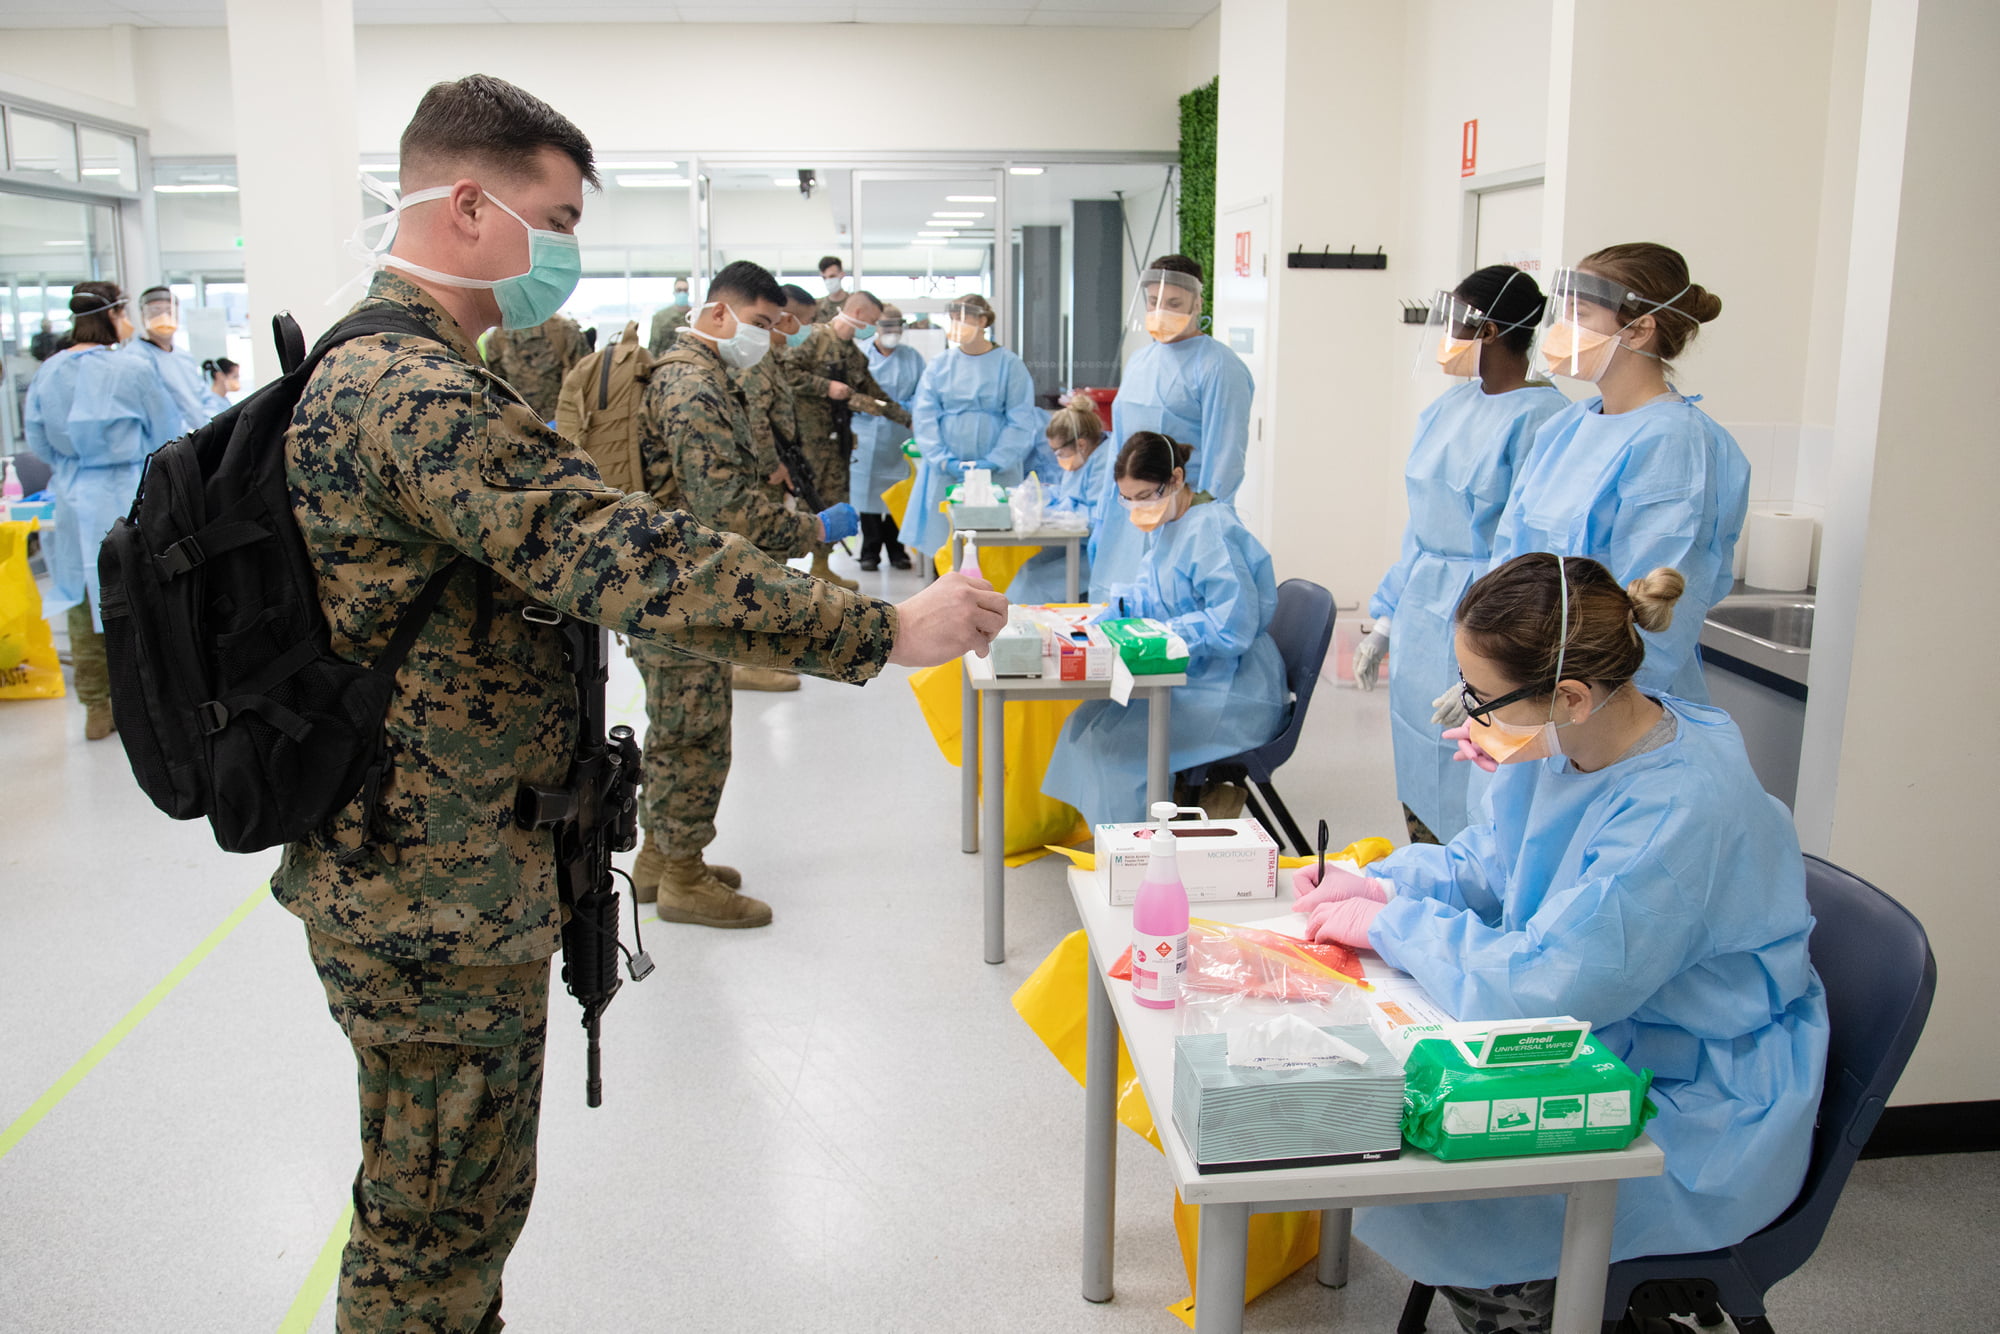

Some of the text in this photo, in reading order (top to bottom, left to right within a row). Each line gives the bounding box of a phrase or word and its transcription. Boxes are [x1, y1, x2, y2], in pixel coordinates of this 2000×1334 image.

[1403, 1024, 1444, 1040] clinell
[1518, 1035, 1554, 1045] clinell
[1494, 1041, 1574, 1053] UNIVERSAL WIPES
